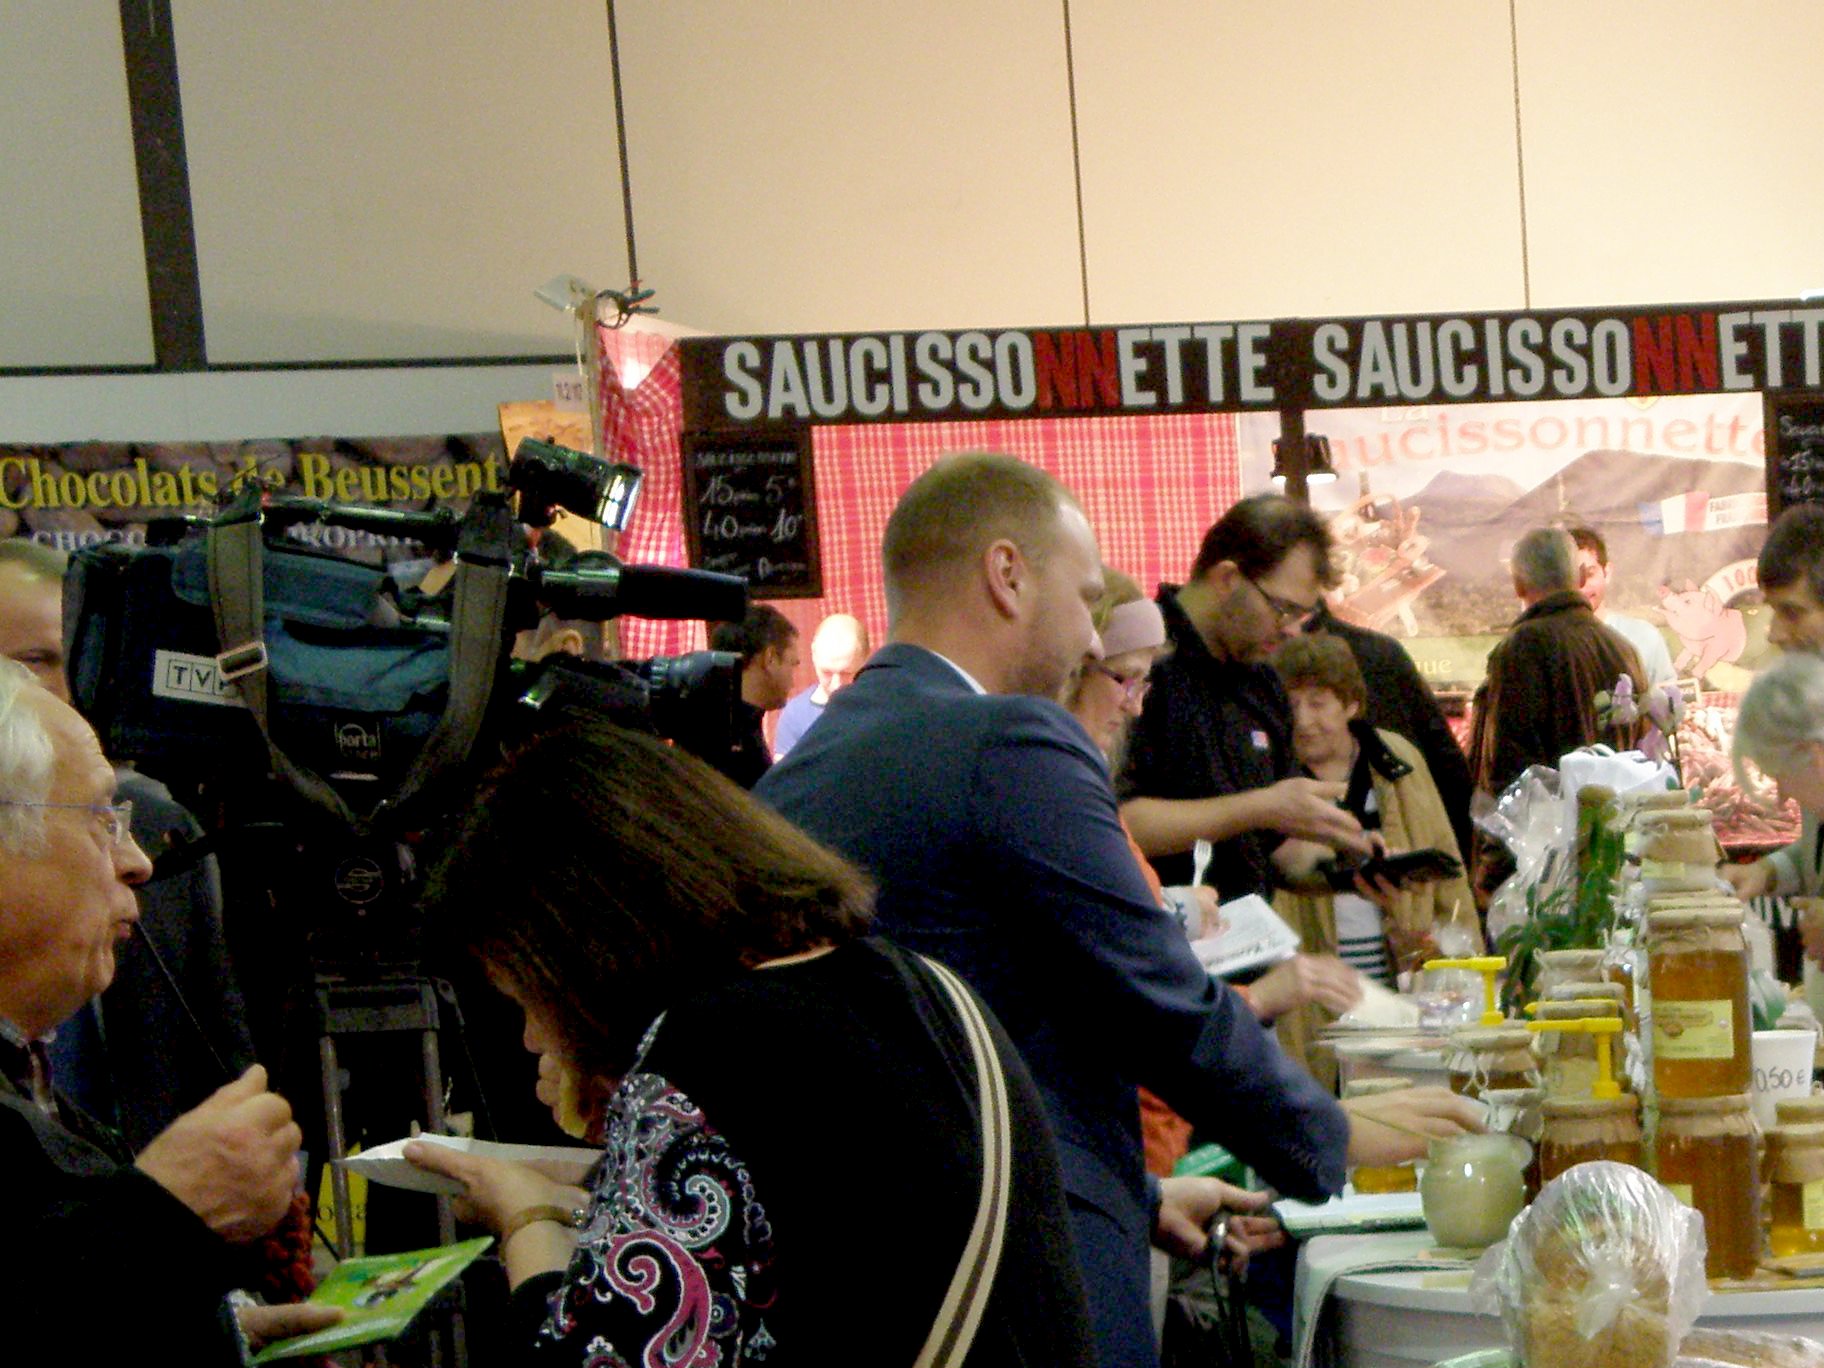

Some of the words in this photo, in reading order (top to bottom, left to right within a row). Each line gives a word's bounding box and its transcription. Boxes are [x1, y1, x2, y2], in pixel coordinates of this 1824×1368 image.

[722, 322, 1275, 421] SAUCISSONNETTE
[1331, 412, 1765, 469] aucissonnett
[0, 457, 217, 509] Chocolats
[301, 451, 500, 501] Beussent
[173, 664, 230, 691] TV
